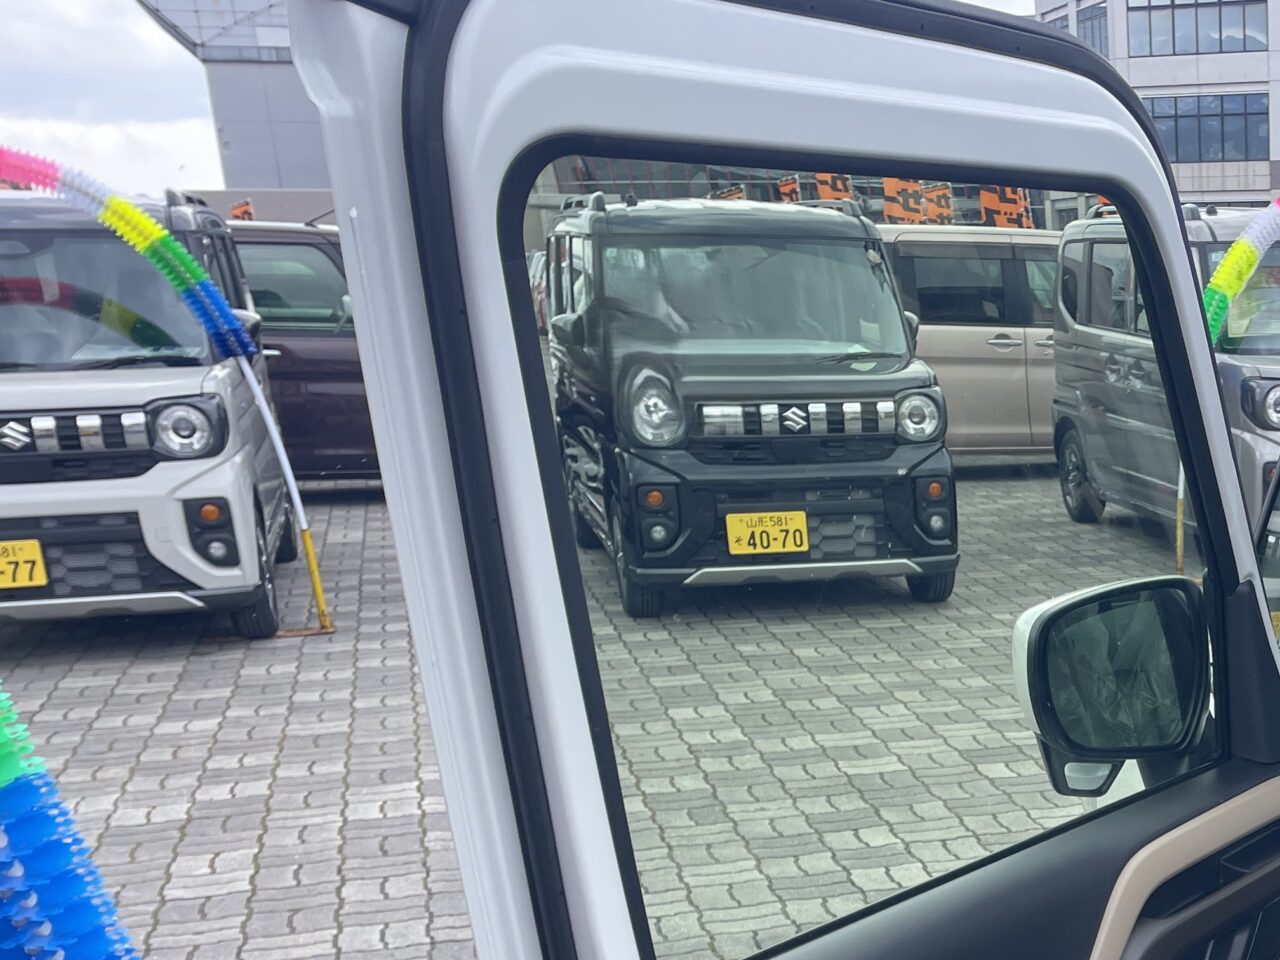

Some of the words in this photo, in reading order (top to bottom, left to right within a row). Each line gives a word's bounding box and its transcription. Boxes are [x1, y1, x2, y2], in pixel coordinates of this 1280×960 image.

[746, 517, 769, 528] 山形
[769, 516, 788, 527] 581
[747, 528, 804, 550] 40-70
[0, 546, 17, 558] 81
